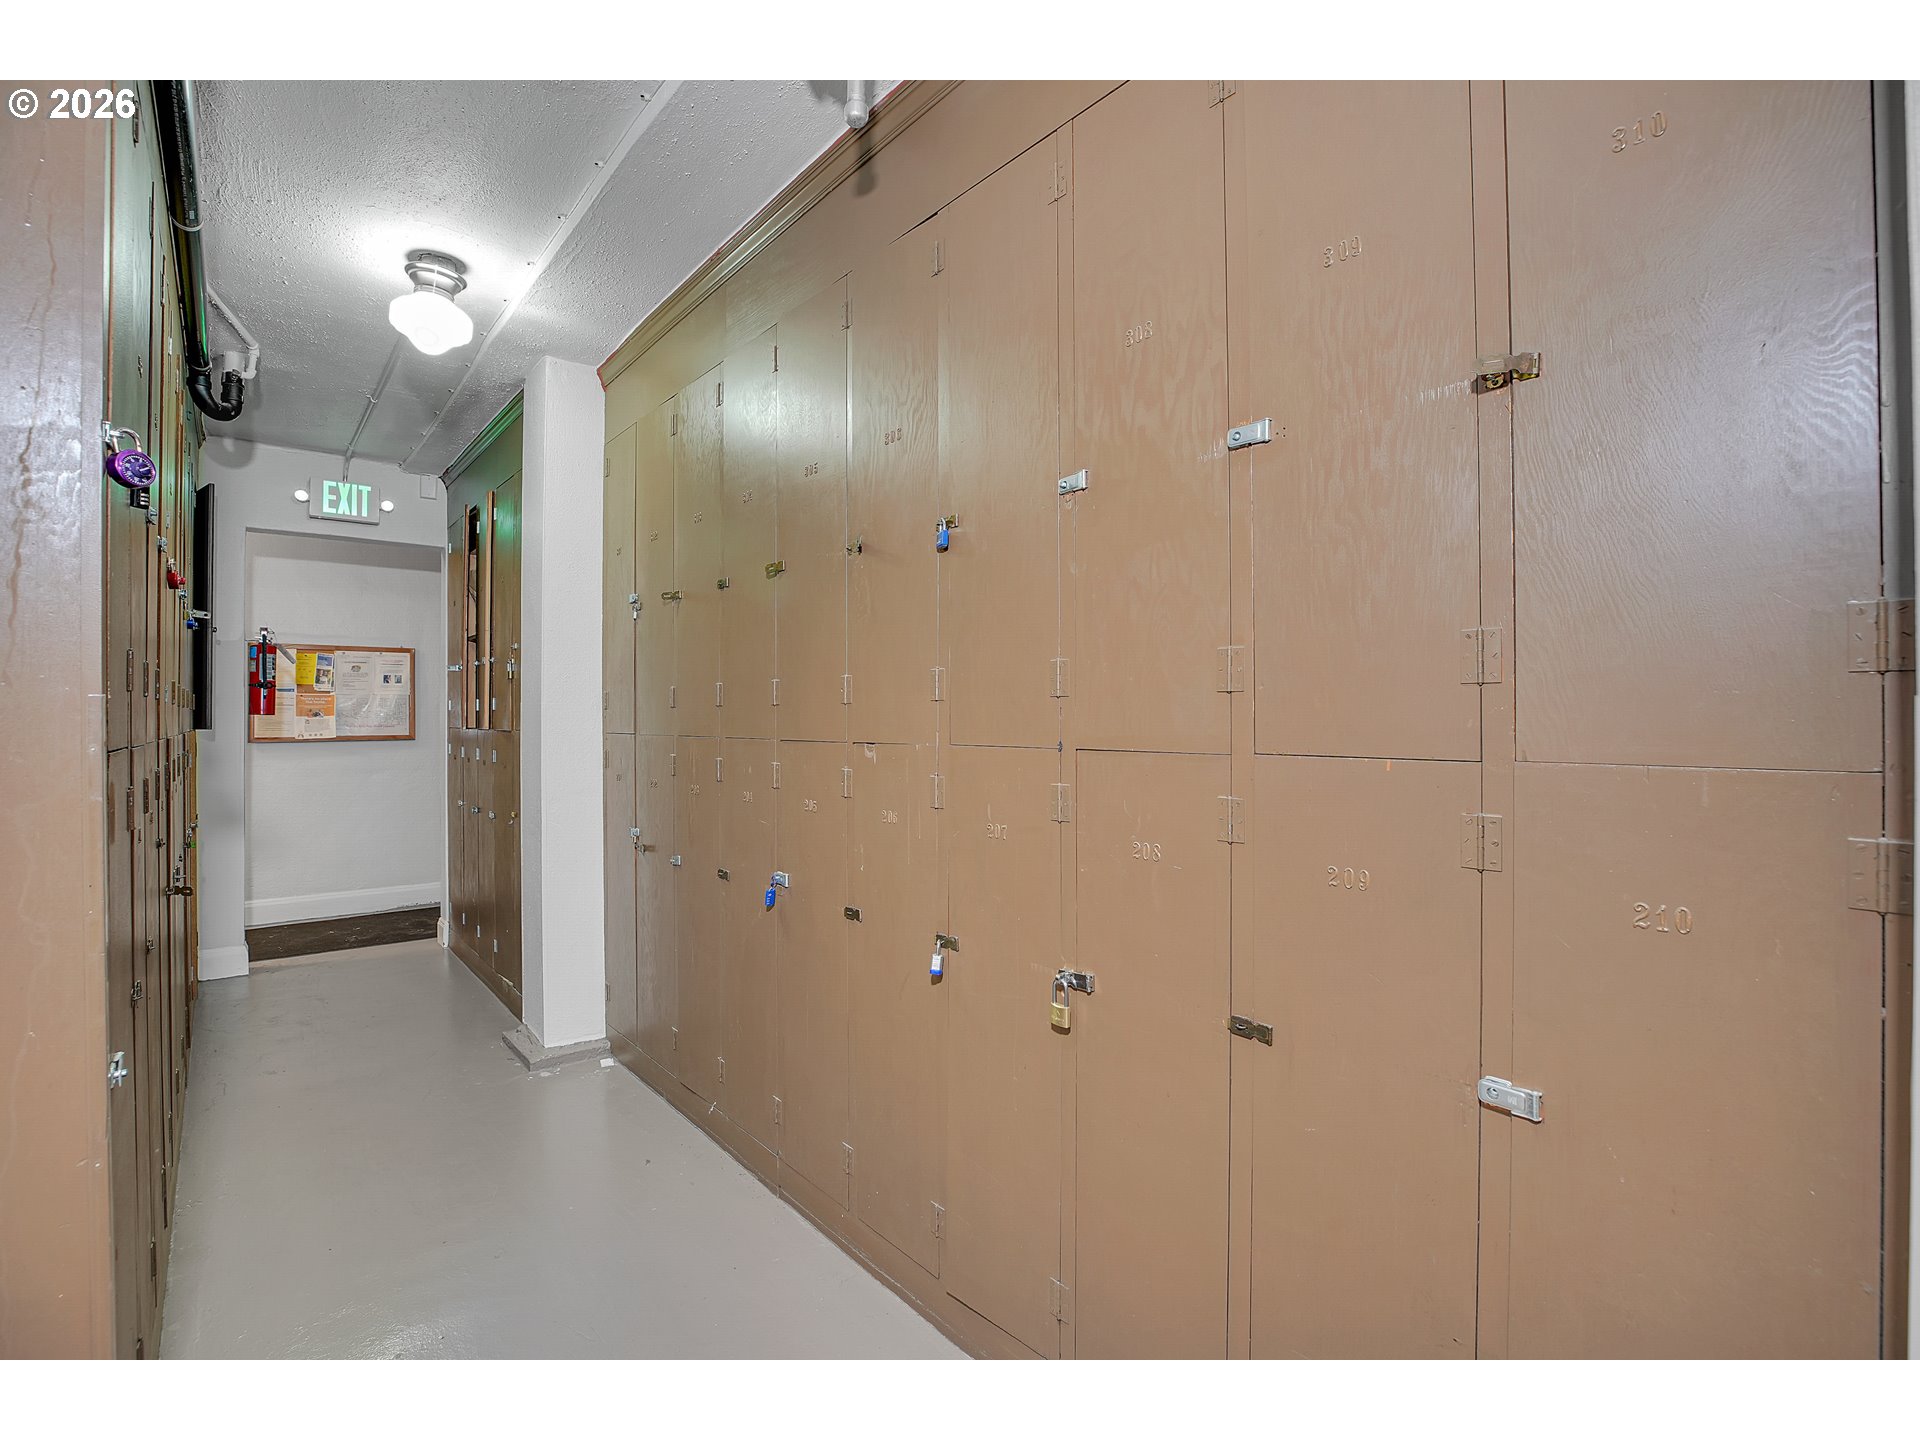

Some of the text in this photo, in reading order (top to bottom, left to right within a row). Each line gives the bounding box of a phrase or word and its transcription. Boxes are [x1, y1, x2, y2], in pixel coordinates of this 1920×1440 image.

[1612, 110, 1667, 153] 310
[1323, 236, 1361, 268] 309
[322, 480, 371, 517] EXIT
[804, 799, 818, 813] 205
[881, 809, 898, 825] 206
[987, 823, 1008, 841] 207
[1132, 841, 1161, 863] 208
[1327, 865, 1370, 892] 209
[1632, 902, 1693, 935] 210
